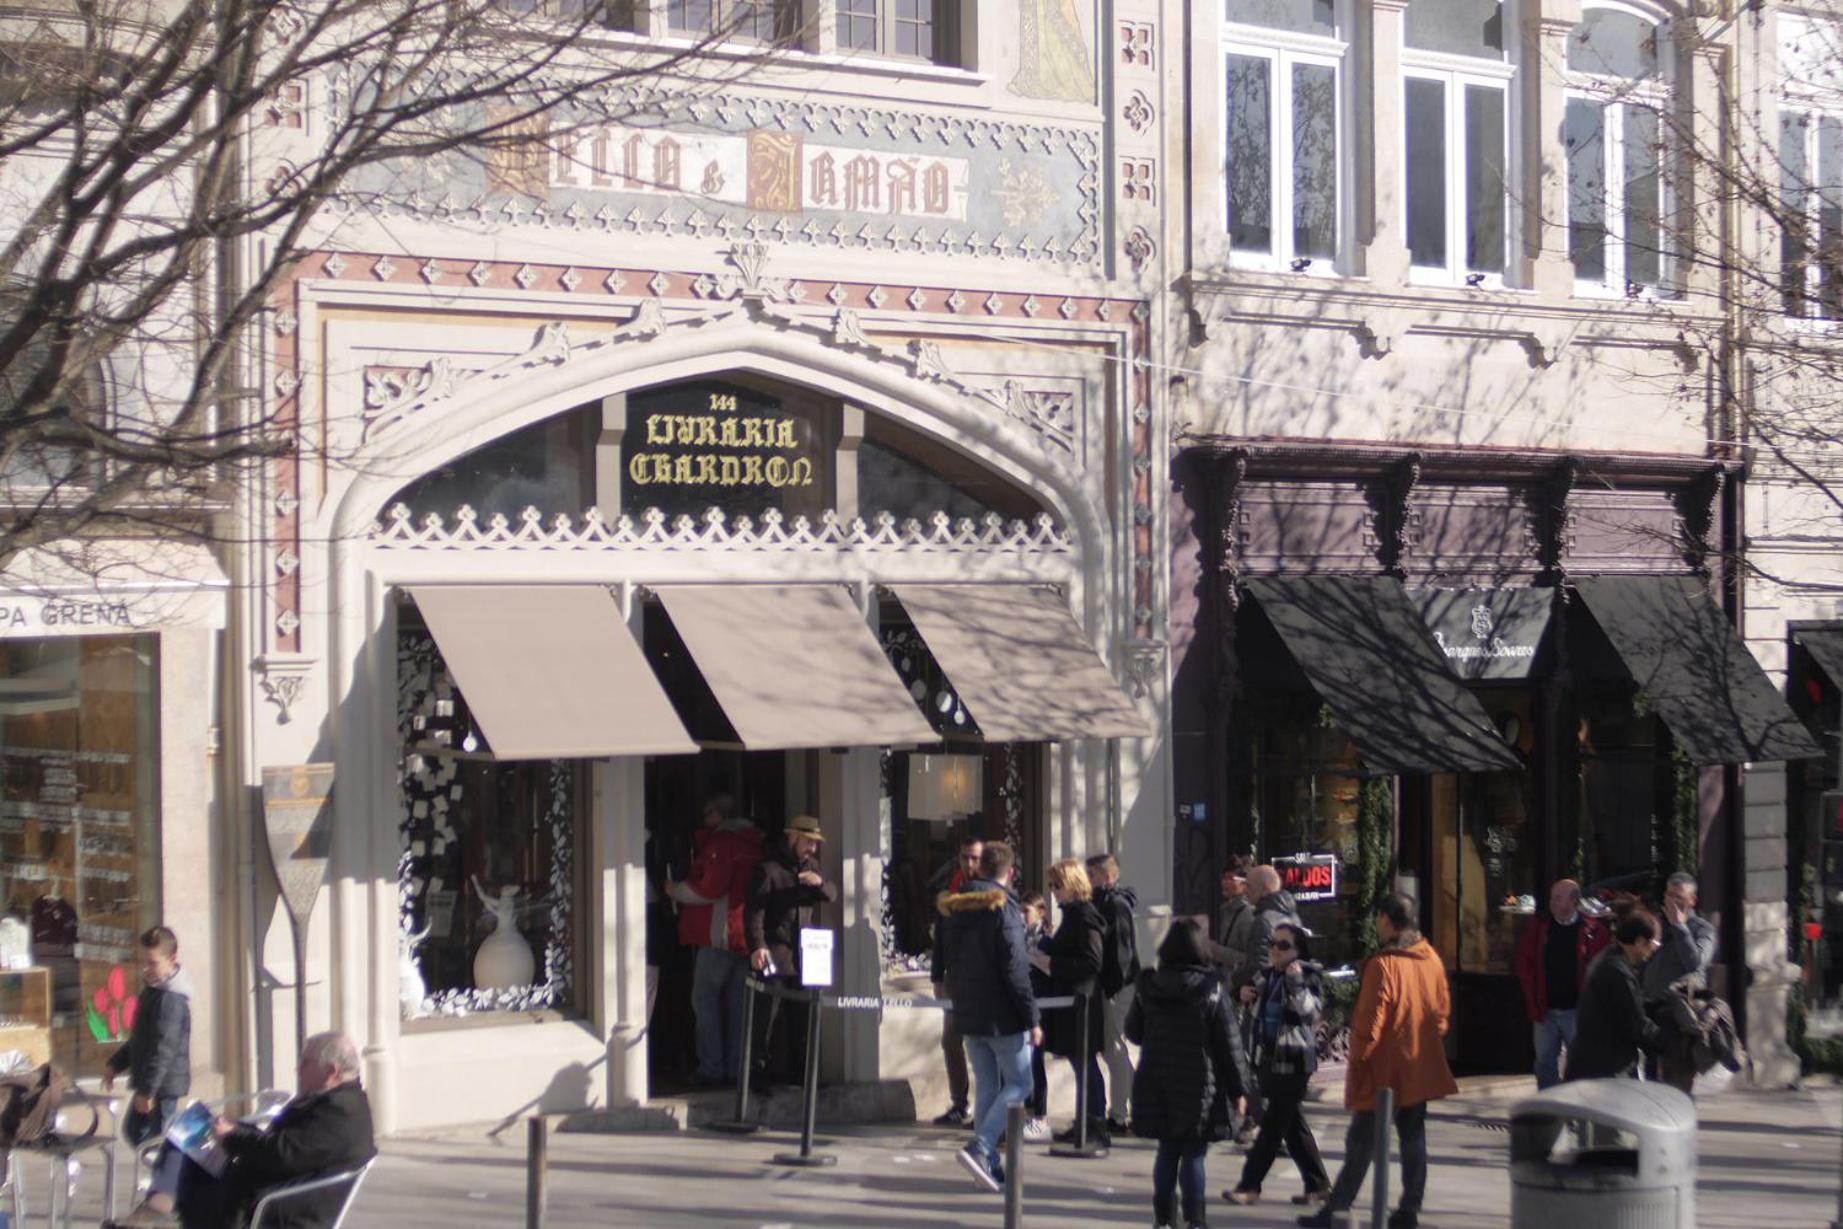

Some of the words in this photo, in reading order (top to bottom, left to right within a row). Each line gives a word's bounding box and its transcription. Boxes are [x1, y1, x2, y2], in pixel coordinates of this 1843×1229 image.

[708, 393, 737, 411] 144
[646, 414, 798, 449] LIVRARIA
[629, 452, 812, 488] CHARDRON
[837, 996, 880, 1008] LIVRARIA
